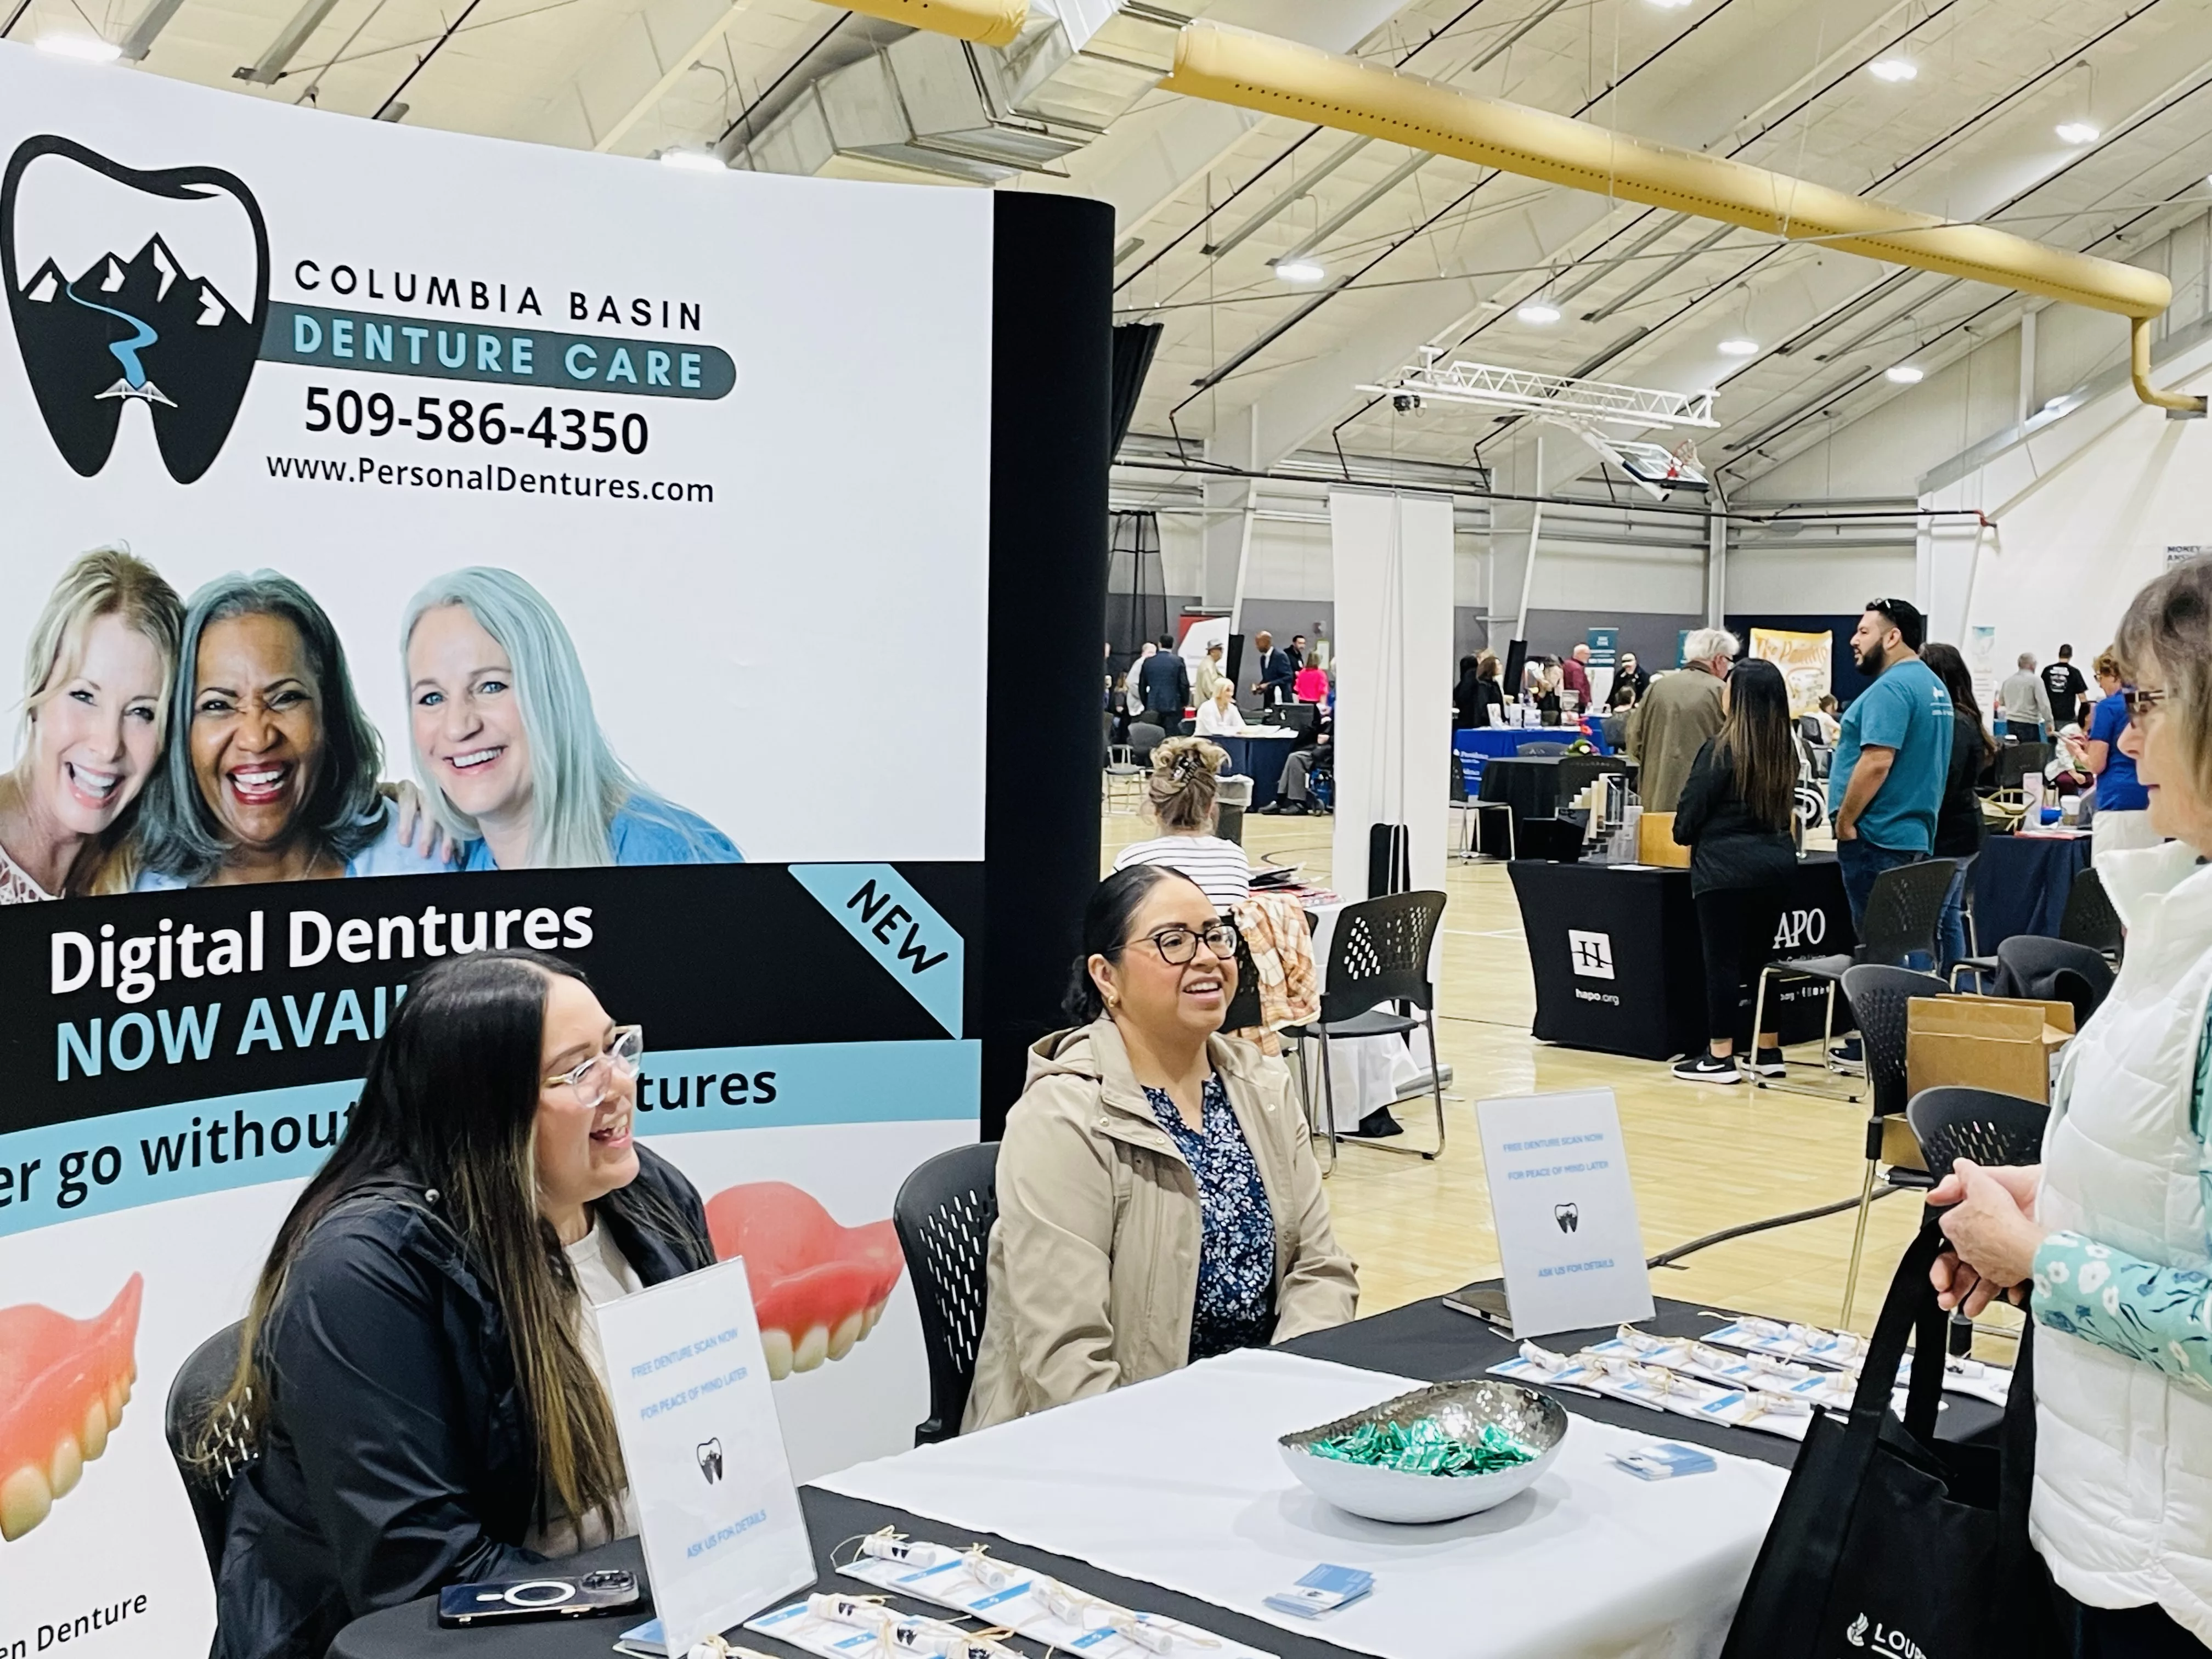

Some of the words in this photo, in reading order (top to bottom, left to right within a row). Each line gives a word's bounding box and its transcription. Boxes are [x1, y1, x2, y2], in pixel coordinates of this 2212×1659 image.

[295, 259, 543, 316] COLUMBIA
[570, 292, 702, 331] BASIN
[294, 313, 533, 375] DENTURE
[564, 343, 702, 388] CARE
[304, 386, 650, 455] 509-586-4350
[266, 453, 715, 504] www.PersonalDentures.com
[847, 879, 949, 974] NEW
[51, 911, 264, 1005] Digital
[289, 905, 594, 968] Dentures
[1575, 988, 1620, 1006] hapo.org
[57, 1002, 221, 1082] NOW
[57, 1144, 121, 1209] go
[635, 1070, 778, 1113] tures
[1503, 1142, 1523, 1153] FREE
[1524, 1138, 1560, 1150] DENTURE
[1561, 1135, 1583, 1146] SCAN
[1584, 1133, 1604, 1142] NOW
[1508, 1171, 1524, 1181] FOR
[1525, 1168, 1550, 1178] PEACE
[1552, 1166, 1562, 1175] OF
[1564, 1164, 1585, 1173] MIND
[1585, 1160, 1609, 1171] LATER
[1538, 1268, 1553, 1277] ASK
[1554, 1266, 1566, 1275] US
[1566, 1263, 1583, 1273] FOR
[1584, 1259, 1615, 1271] DETAILS
[631, 1361, 653, 1379] FREE
[653, 1345, 694, 1370] DENTURE
[693, 1336, 717, 1355] SCAN
[718, 1327, 738, 1344] NOW
[640, 1404, 659, 1421] FOR
[659, 1392, 687, 1413] PEACE
[687, 1386, 699, 1400] OF
[701, 1377, 723, 1394] MIND
[723, 1367, 748, 1386] LATER
[687, 1542, 704, 1559] ASK
[704, 1534, 717, 1550] US
[717, 1526, 735, 1544] FOR
[735, 1509, 767, 1534] DETAILS
[37, 1594, 148, 1652] Denture
